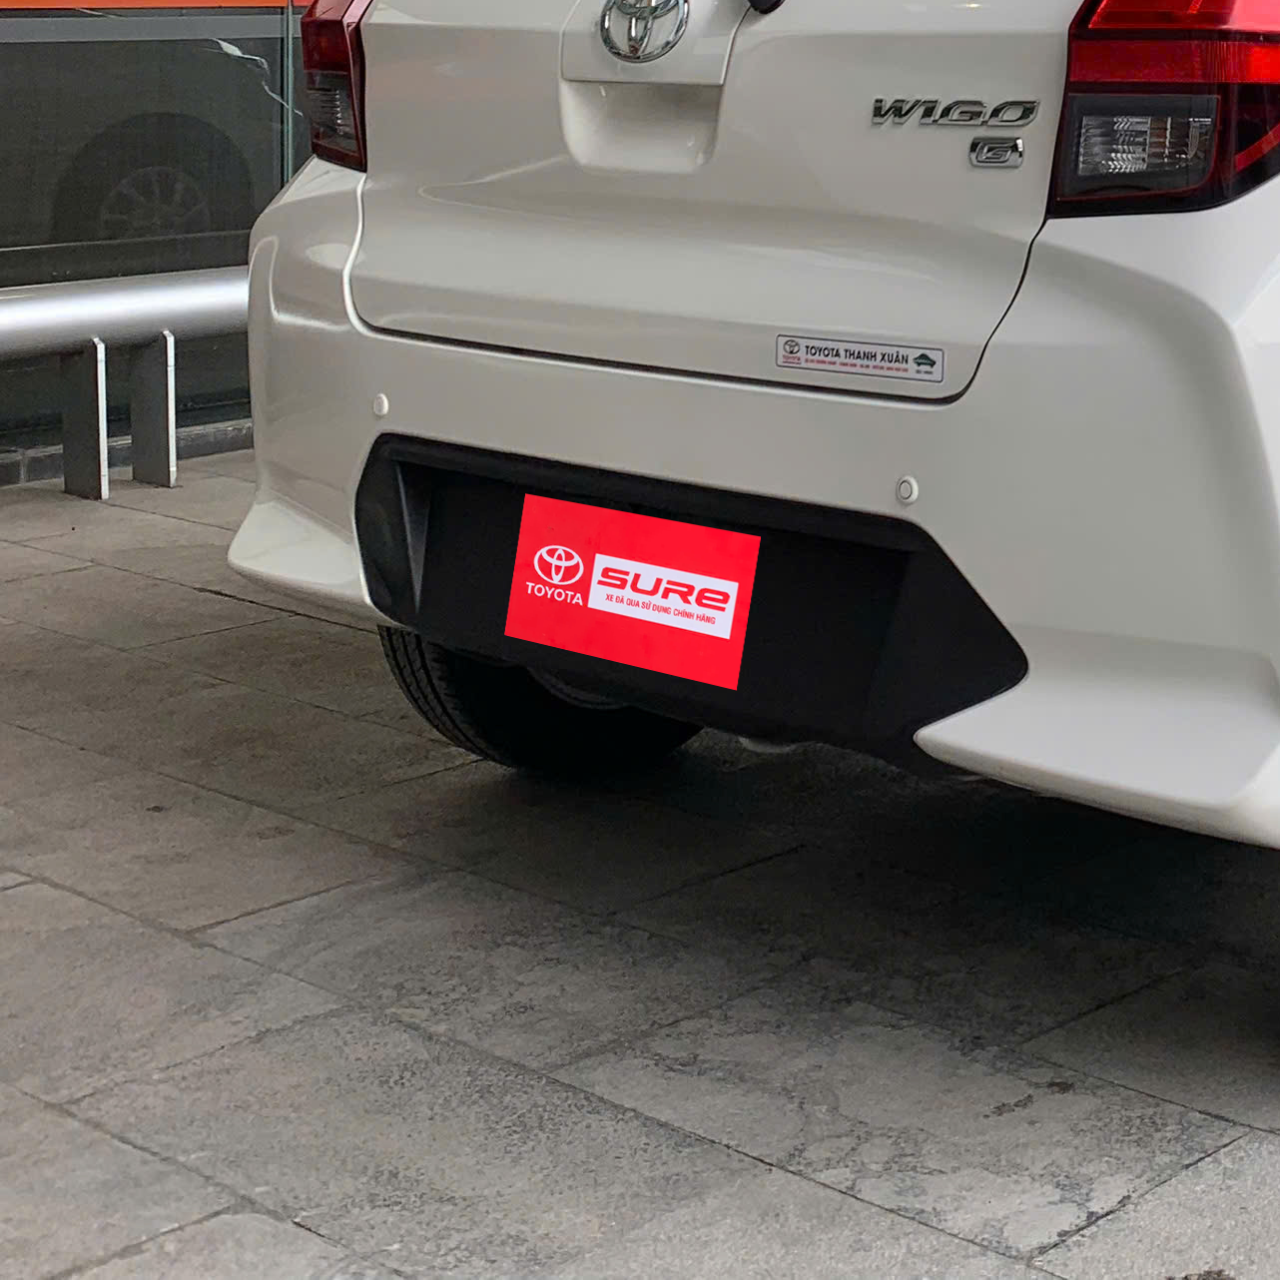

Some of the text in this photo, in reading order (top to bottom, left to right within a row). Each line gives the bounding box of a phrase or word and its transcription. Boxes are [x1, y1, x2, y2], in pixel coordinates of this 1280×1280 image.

[871, 98, 1041, 127] WIGO
[805, 345, 909, 365] TOYOTA THANH XUÂN
[526, 581, 584, 606] TOYOTA
[605, 593, 716, 625] XE ĐÃ QUA SỬ DỤNG CHÍNH HÃNG
